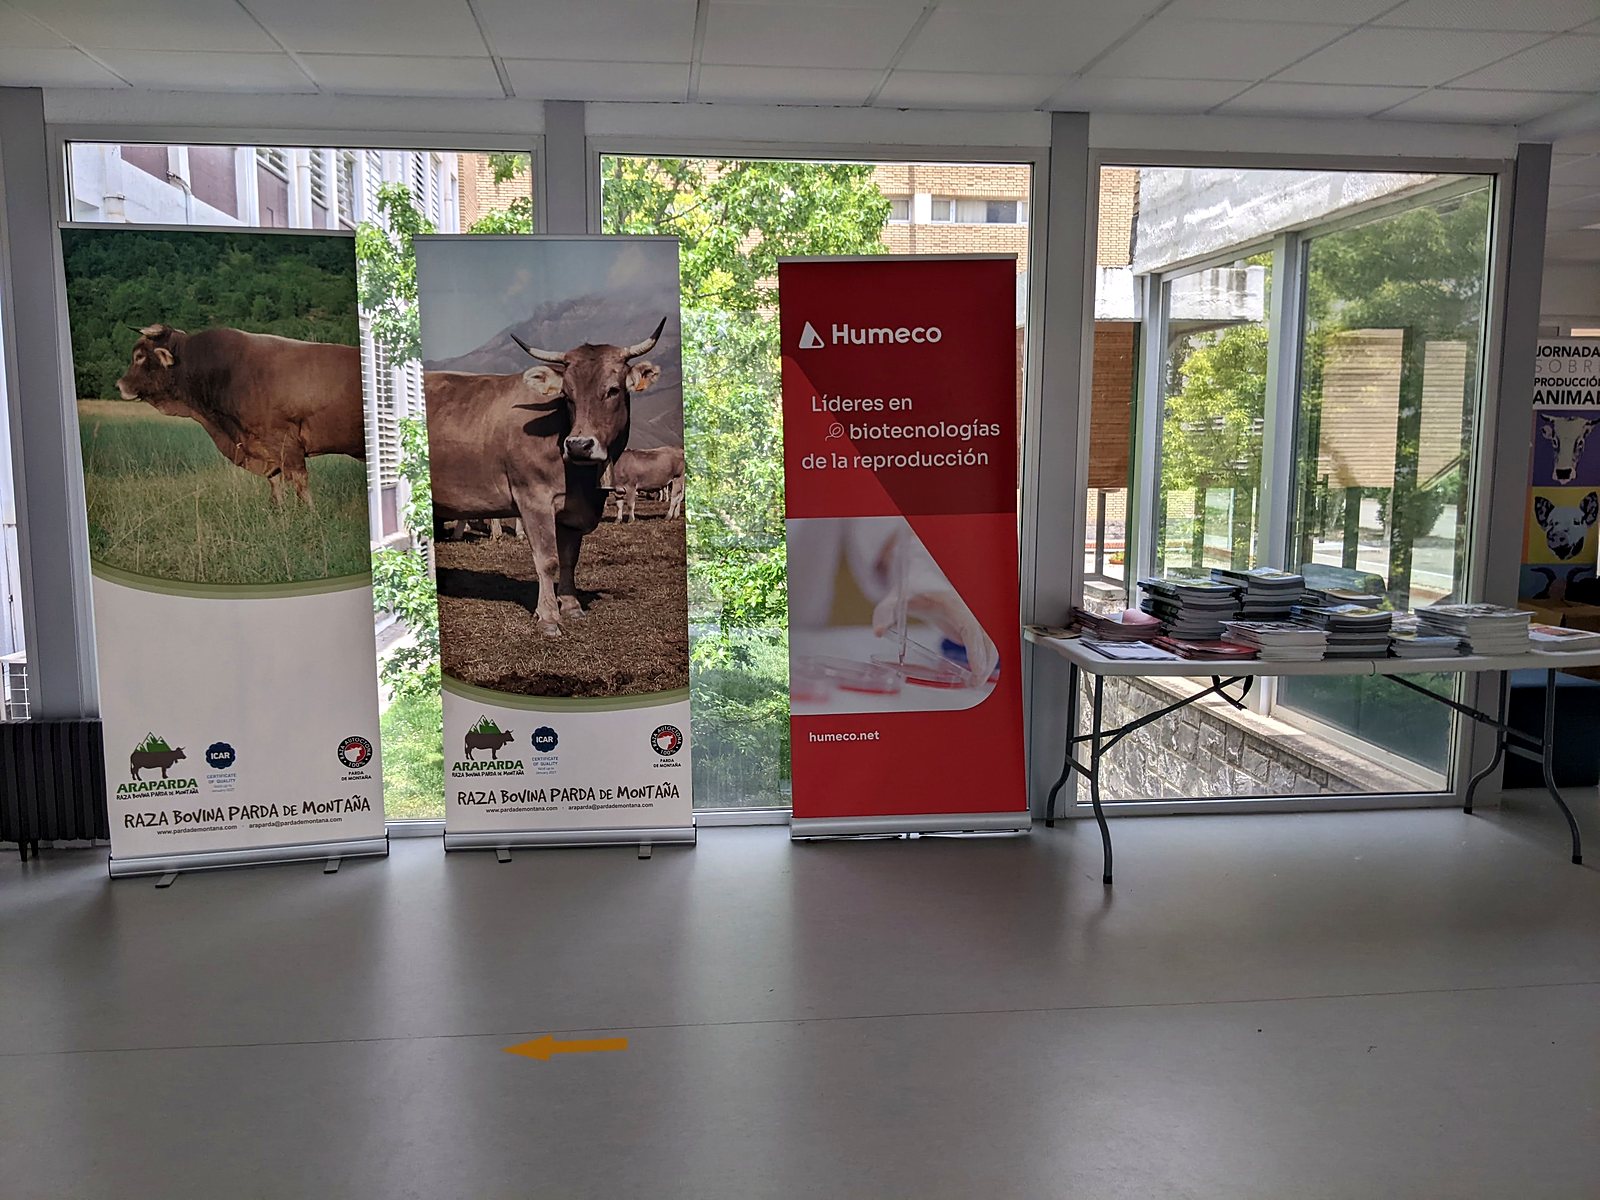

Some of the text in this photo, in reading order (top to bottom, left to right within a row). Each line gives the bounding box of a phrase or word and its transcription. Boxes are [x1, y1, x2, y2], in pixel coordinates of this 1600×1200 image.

[831, 323, 942, 345] Humeco
[1535, 359, 1600, 373] SOBR
[1534, 375, 1600, 387] PRODUCCIÓ
[811, 394, 913, 412] Líderes en
[849, 419, 1000, 441] biotecnologías
[801, 448, 989, 471] de la reproducción
[809, 730, 880, 742] humeco.net
[210, 751, 230, 760] ICAR
[452, 760, 524, 771] ARAPARDA
[117, 778, 199, 794] ARAPARDA
[150, 790, 169, 798] PARDA
[458, 781, 680, 805] RAZA BOVINA PARDA DE MONTAÑA
[124, 794, 371, 828] RAZA BOVINA PARDA DE MONTAÑA
[568, 803, 654, 811] araparda@pardademontana.com
[157, 817, 343, 835] www.pardademontana.com araparda@pardademontana.com
